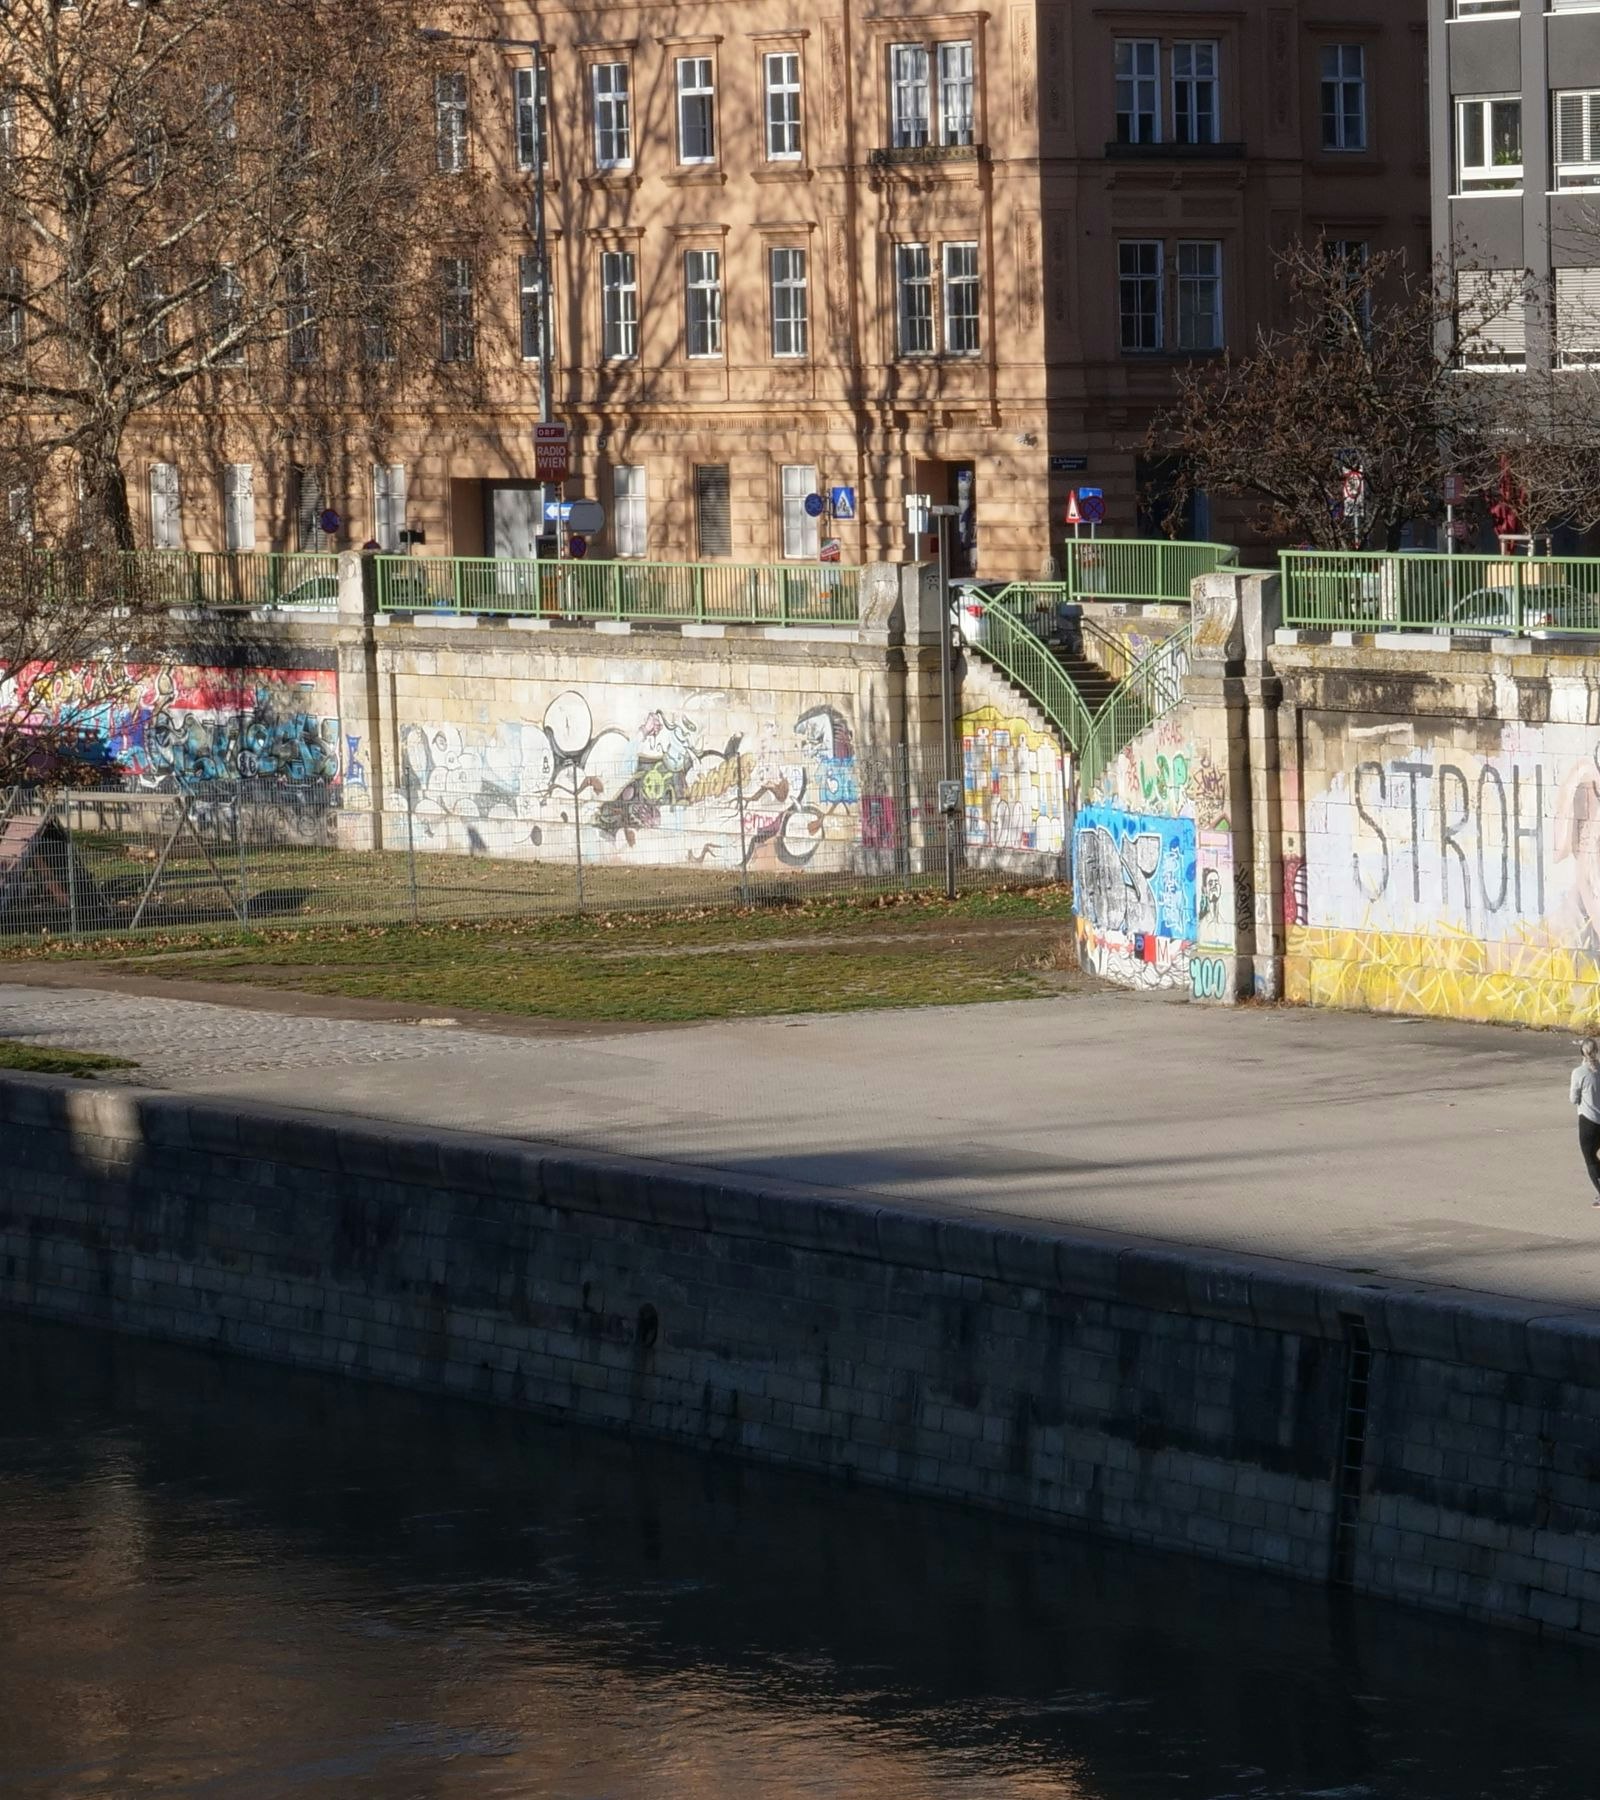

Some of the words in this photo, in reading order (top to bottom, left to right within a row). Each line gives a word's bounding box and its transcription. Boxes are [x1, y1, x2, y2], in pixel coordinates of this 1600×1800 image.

[538, 429, 556, 437] ORF
[537, 446, 566, 456] RADIO
[537, 457, 566, 468] WIEN
[1353, 759, 1544, 932] STROH
